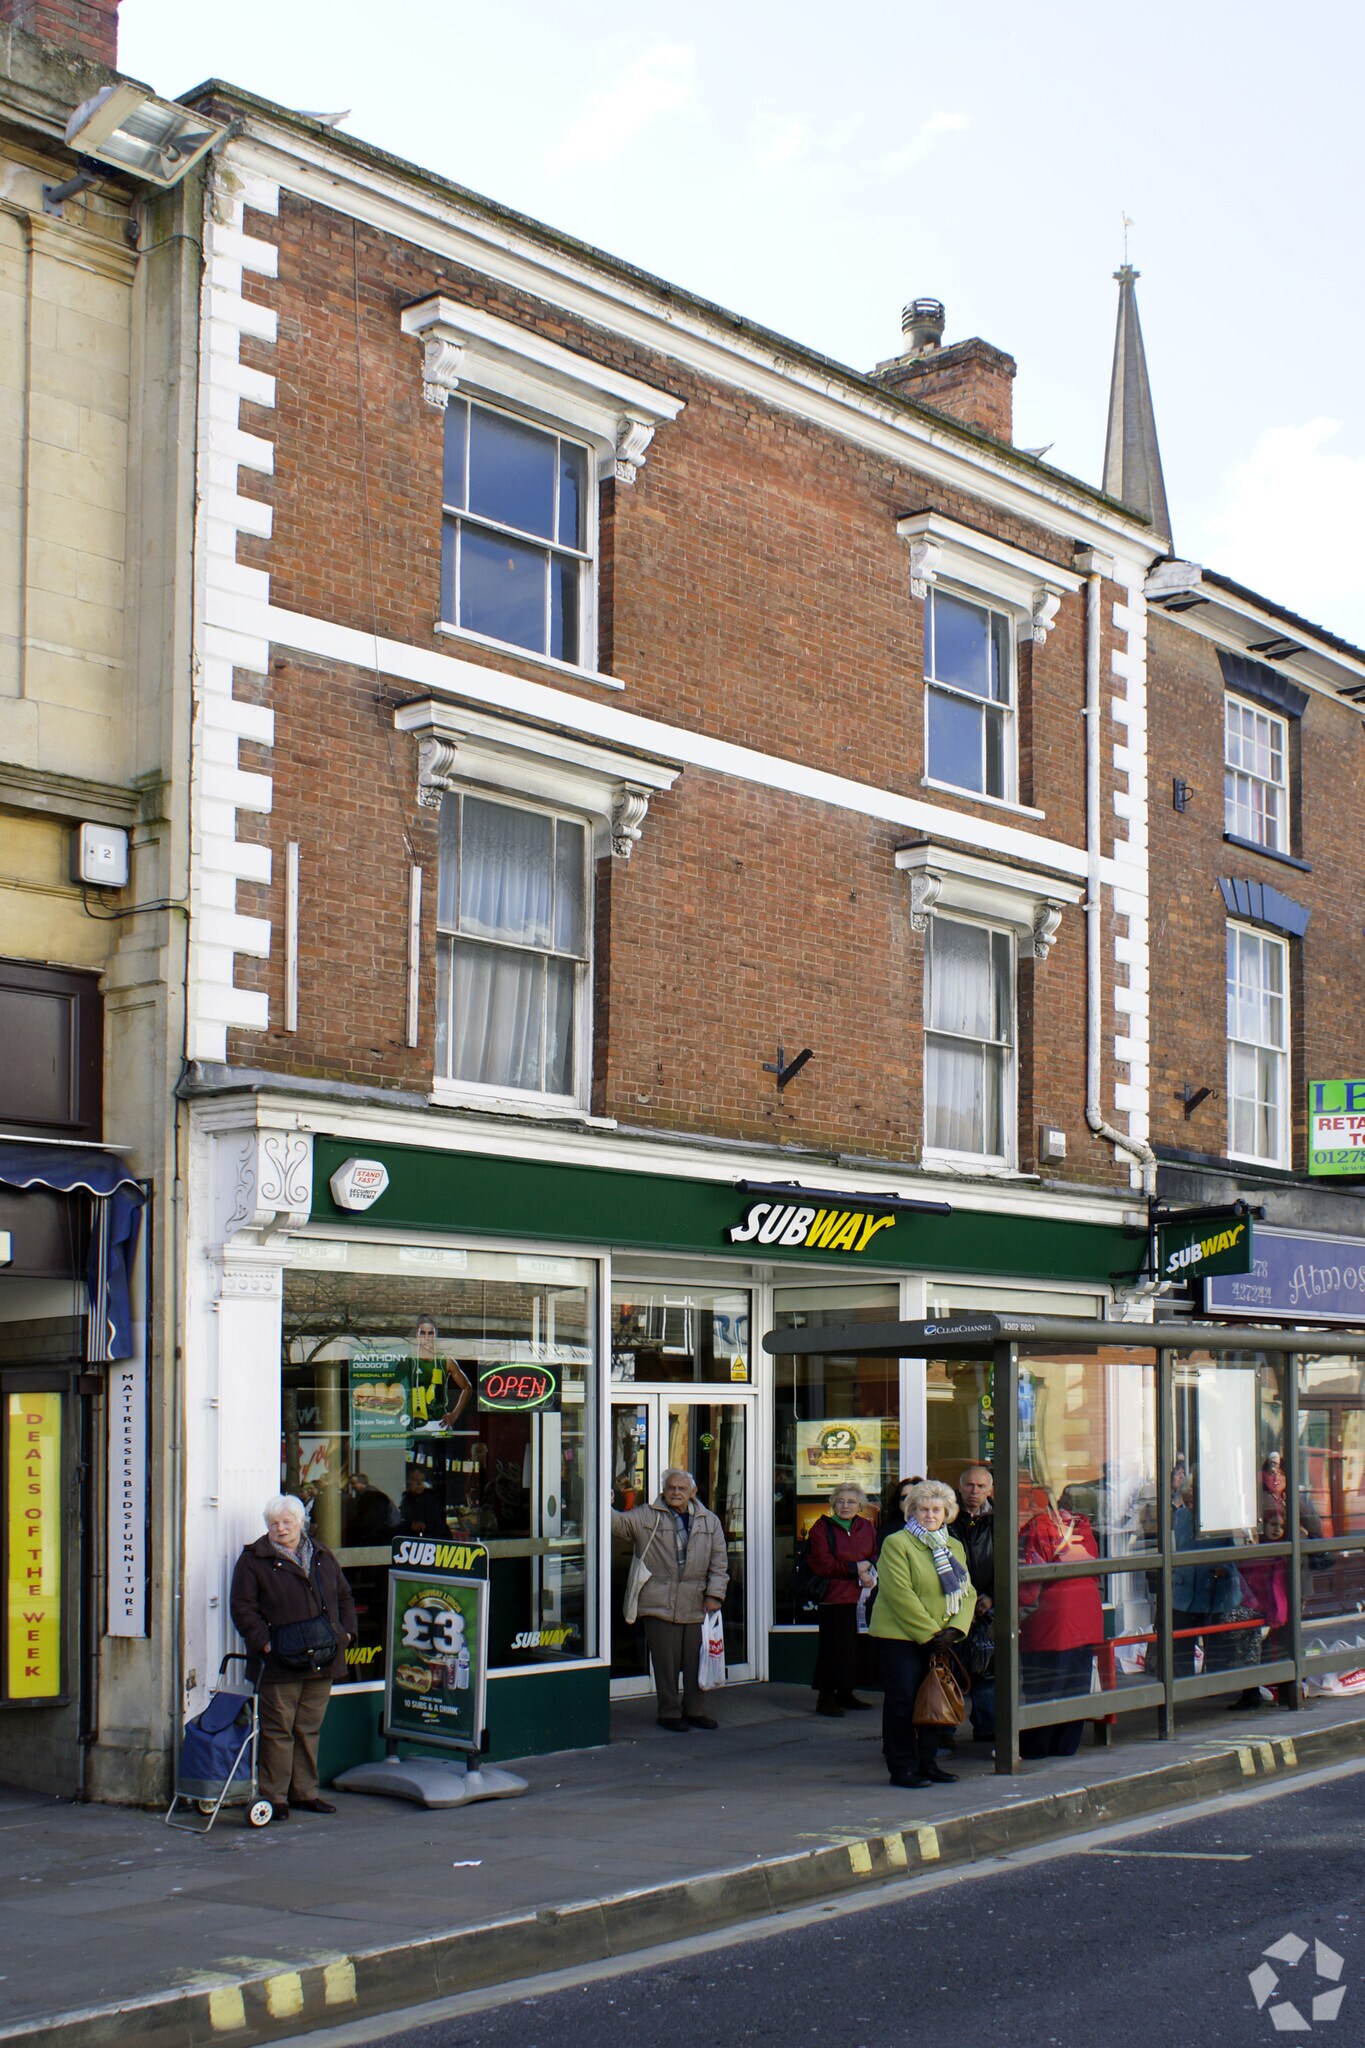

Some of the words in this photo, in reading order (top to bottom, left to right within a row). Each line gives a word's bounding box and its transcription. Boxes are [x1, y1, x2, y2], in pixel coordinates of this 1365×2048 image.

[103, 848, 112, 859] 2
[1349, 1133, 1365, 1146] T
[356, 1170, 381, 1178] STAND
[730, 1203, 896, 1252] SUBWAY
[1166, 1223, 1246, 1274] SUBWAY
[1232, 1281, 1272, 1305] 427244
[1003, 1322, 1019, 1331] 4302
[1020, 1323, 1036, 1332] 0024
[353, 1353, 408, 1362] ANTHONY
[486, 1374, 547, 1398] OPEN
[826, 1430, 851, 1450] £2
[24, 1413, 43, 1495] DEALS
[24, 1508, 43, 1537] OF
[393, 1540, 486, 1570] SUBWAY
[27, 1549, 43, 1597] THE
[401, 1607, 466, 1655] £3
[510, 1627, 574, 1650] SUBWAY
[22, 1612, 46, 1677] WEEK
[411, 1700, 427, 1710] SUBS
